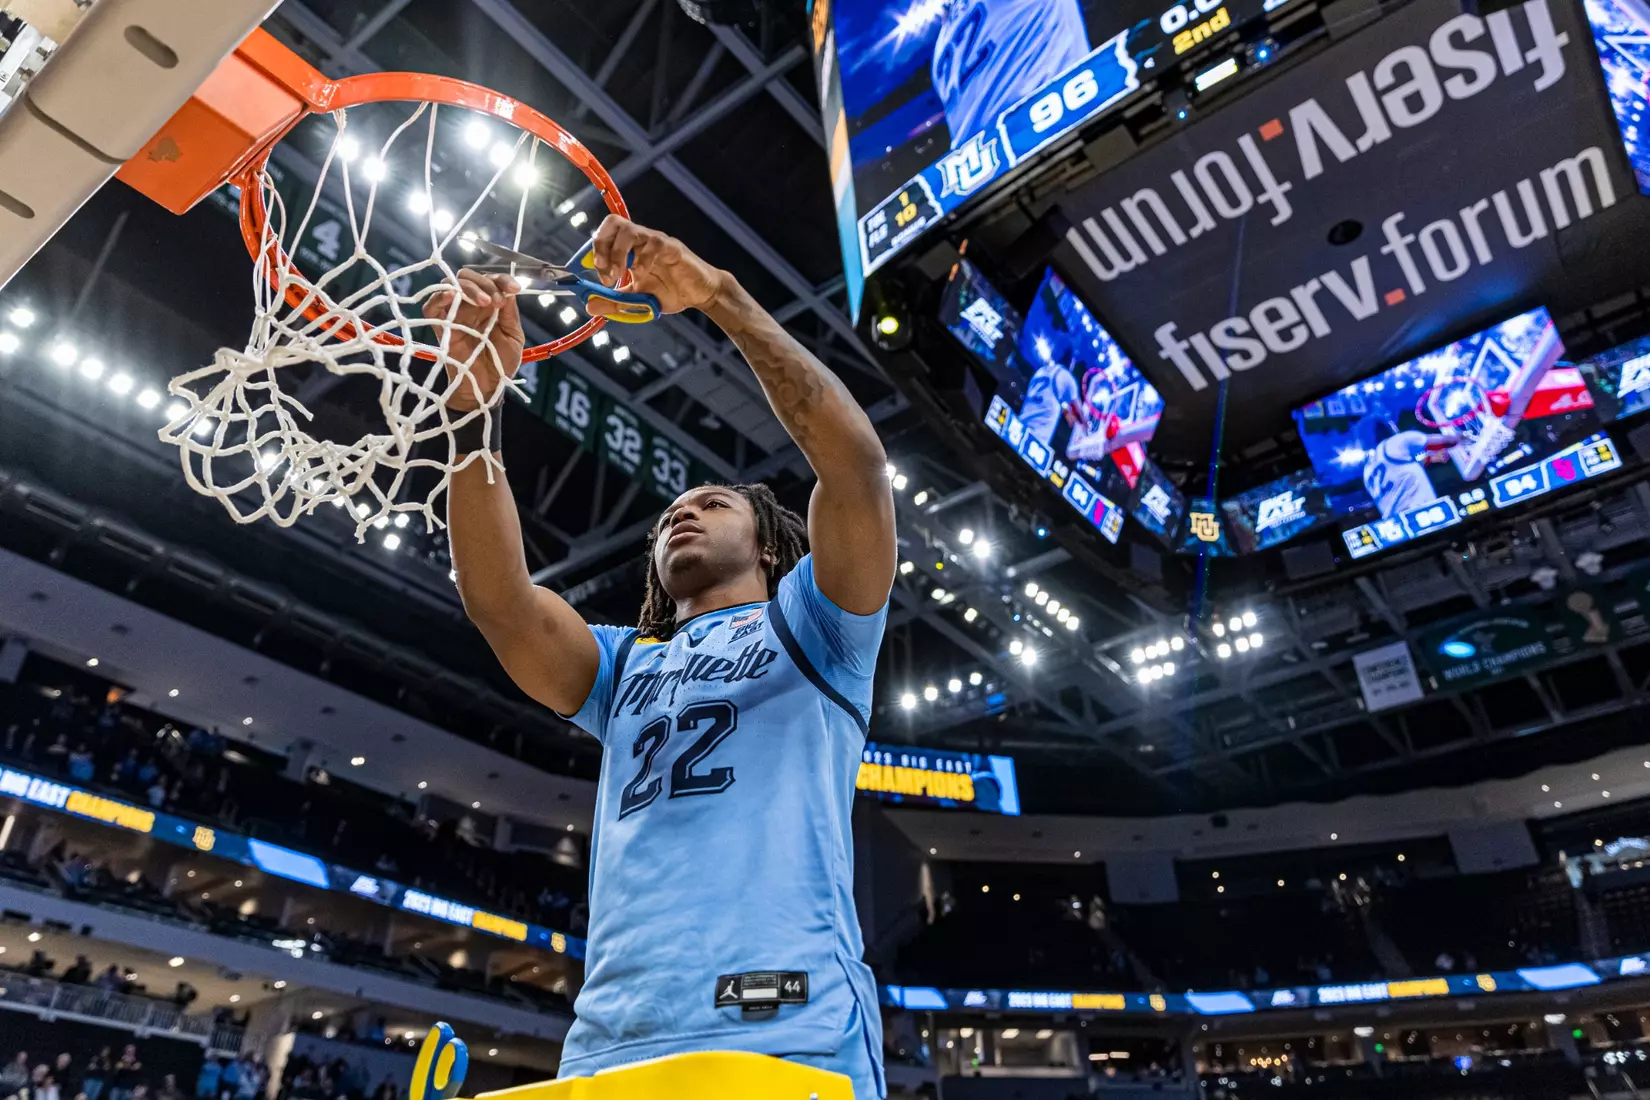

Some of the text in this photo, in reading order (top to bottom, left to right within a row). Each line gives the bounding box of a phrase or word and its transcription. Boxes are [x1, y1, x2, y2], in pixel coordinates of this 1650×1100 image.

[1172, 7, 1231, 55] 2nd
[1029, 69, 1099, 133] 96
[895, 203, 917, 227] 10
[312, 219, 342, 260] 4
[1154, 146, 1616, 390] fiserv.forum
[555, 380, 591, 427] 16
[605, 415, 642, 465] 32
[652, 448, 687, 493] 33
[618, 700, 736, 821] 22
[856, 762, 975, 801] CHAMPIONS
[784, 980, 801, 993] 44
